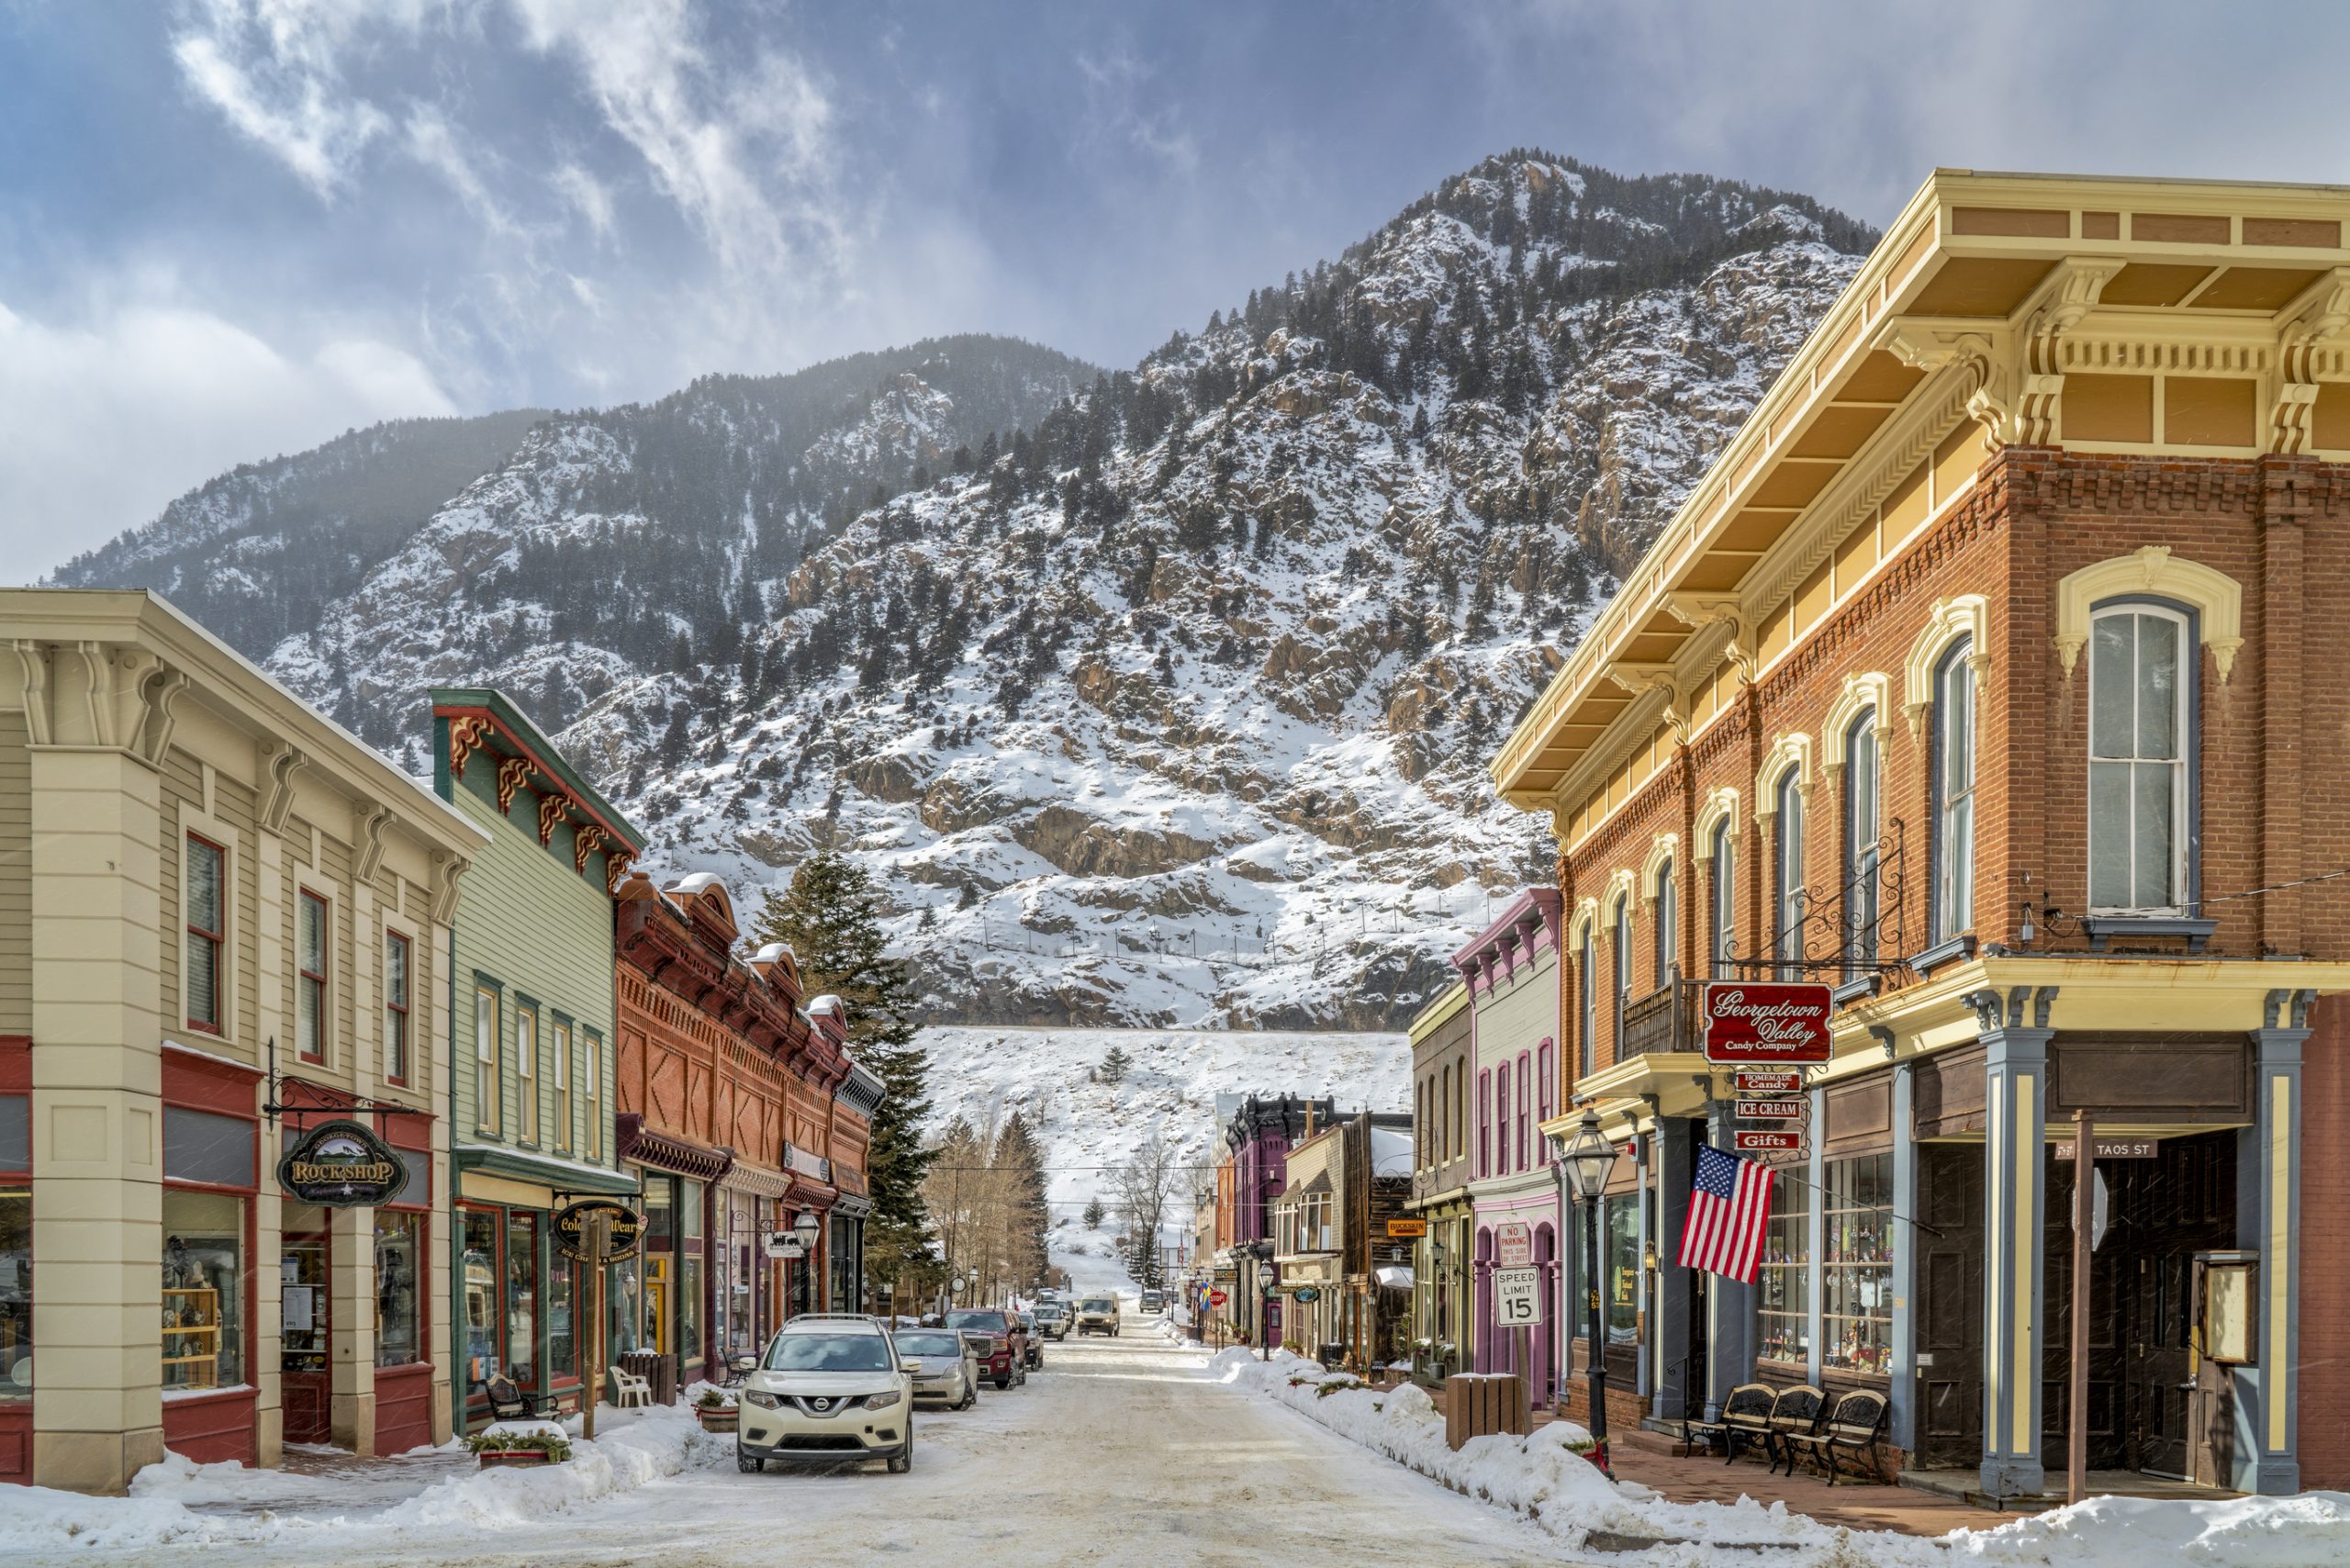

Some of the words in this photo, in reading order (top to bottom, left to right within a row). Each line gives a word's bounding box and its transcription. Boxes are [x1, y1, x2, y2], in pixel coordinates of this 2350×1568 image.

[1713, 990, 1823, 1026] Georgetown
[1757, 1018, 1818, 1047] Valley
[1725, 1040, 1754, 1052] Candy
[1755, 1040, 1797, 1052] Company
[1747, 1081, 1789, 1090] Candy
[1740, 1103, 1757, 1114] ICE
[1759, 1103, 1796, 1115] CREAM
[314, 1130, 367, 1150] GEORGETOWN
[1744, 1134, 1787, 1147] Gifts
[2097, 1145, 2129, 1155] TAOS
[2133, 1144, 2150, 1155] ST
[293, 1160, 341, 1184] ROCK
[341, 1160, 395, 1184] SHOP
[610, 1219, 635, 1233] Wear
[1390, 1222, 1424, 1230] BUCKSKIN
[1507, 1227, 1518, 1236] NO
[1501, 1237, 1527, 1247] PARKING
[561, 1248, 574, 1259] ICE
[610, 1250, 634, 1263] SODAS
[1499, 1272, 1536, 1283] SPEED
[1503, 1285, 1532, 1295] LIMIT
[1505, 1297, 1532, 1319] 15
